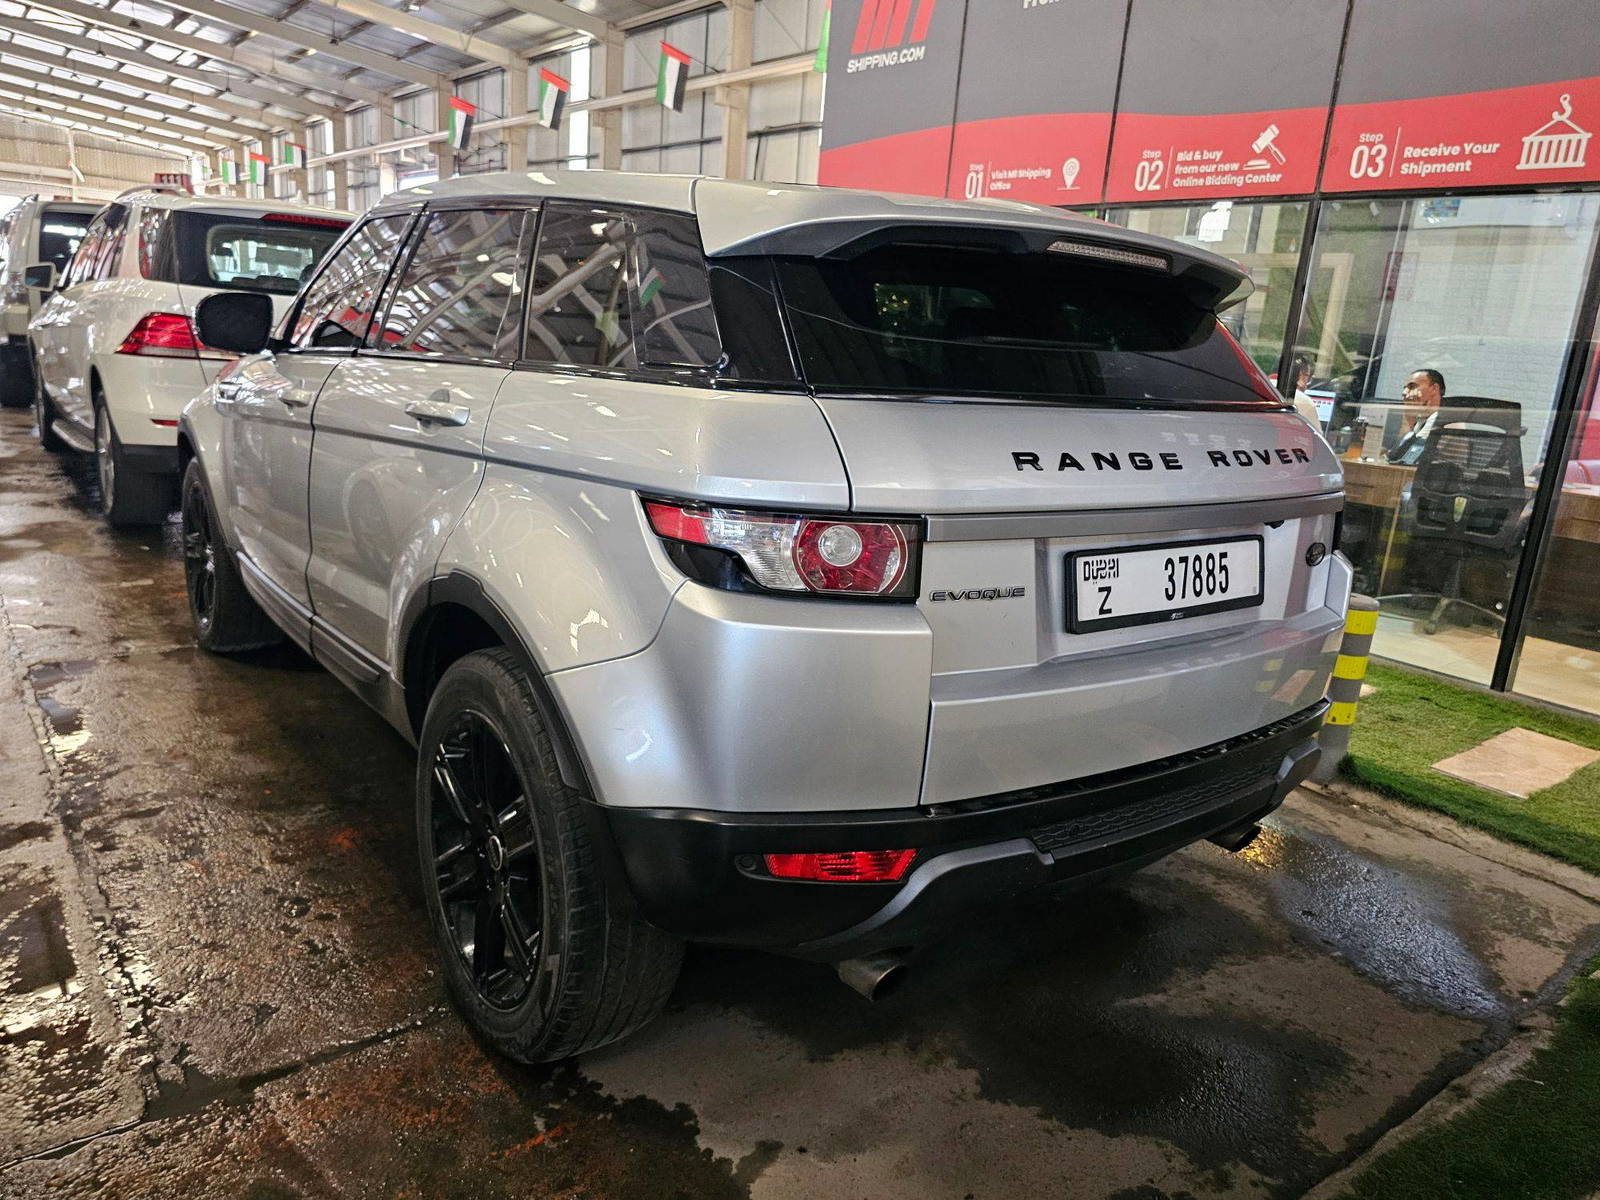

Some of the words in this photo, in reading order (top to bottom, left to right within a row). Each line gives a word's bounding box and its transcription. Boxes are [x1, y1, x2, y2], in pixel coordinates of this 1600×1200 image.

[846, 46, 926, 74] SHIPPING.COM
[1359, 132, 1384, 144] Step
[1142, 149, 1162, 160] Step
[1177, 151, 1193, 162] Bid
[1193, 151, 1201, 161] &
[1202, 150, 1223, 162] buy
[1403, 143, 1461, 159] Receive
[1463, 141, 1501, 156] Your
[1175, 163, 1198, 174] from
[1199, 164, 1216, 173] our
[1217, 163, 1239, 172] new
[1349, 143, 1388, 179] 03
[965, 171, 984, 199] 01
[1134, 159, 1164, 192] 02
[1173, 176, 1204, 188] Online
[1205, 174, 1244, 187] Bidding
[1245, 172, 1282, 184] Center
[1011, 451, 1184, 472] RANGE
[1206, 447, 1311, 468] ROVER
[1164, 551, 1230, 602] 37885
[930, 587, 1026, 602] EVOQUE
[1097, 586, 1113, 615] Z
